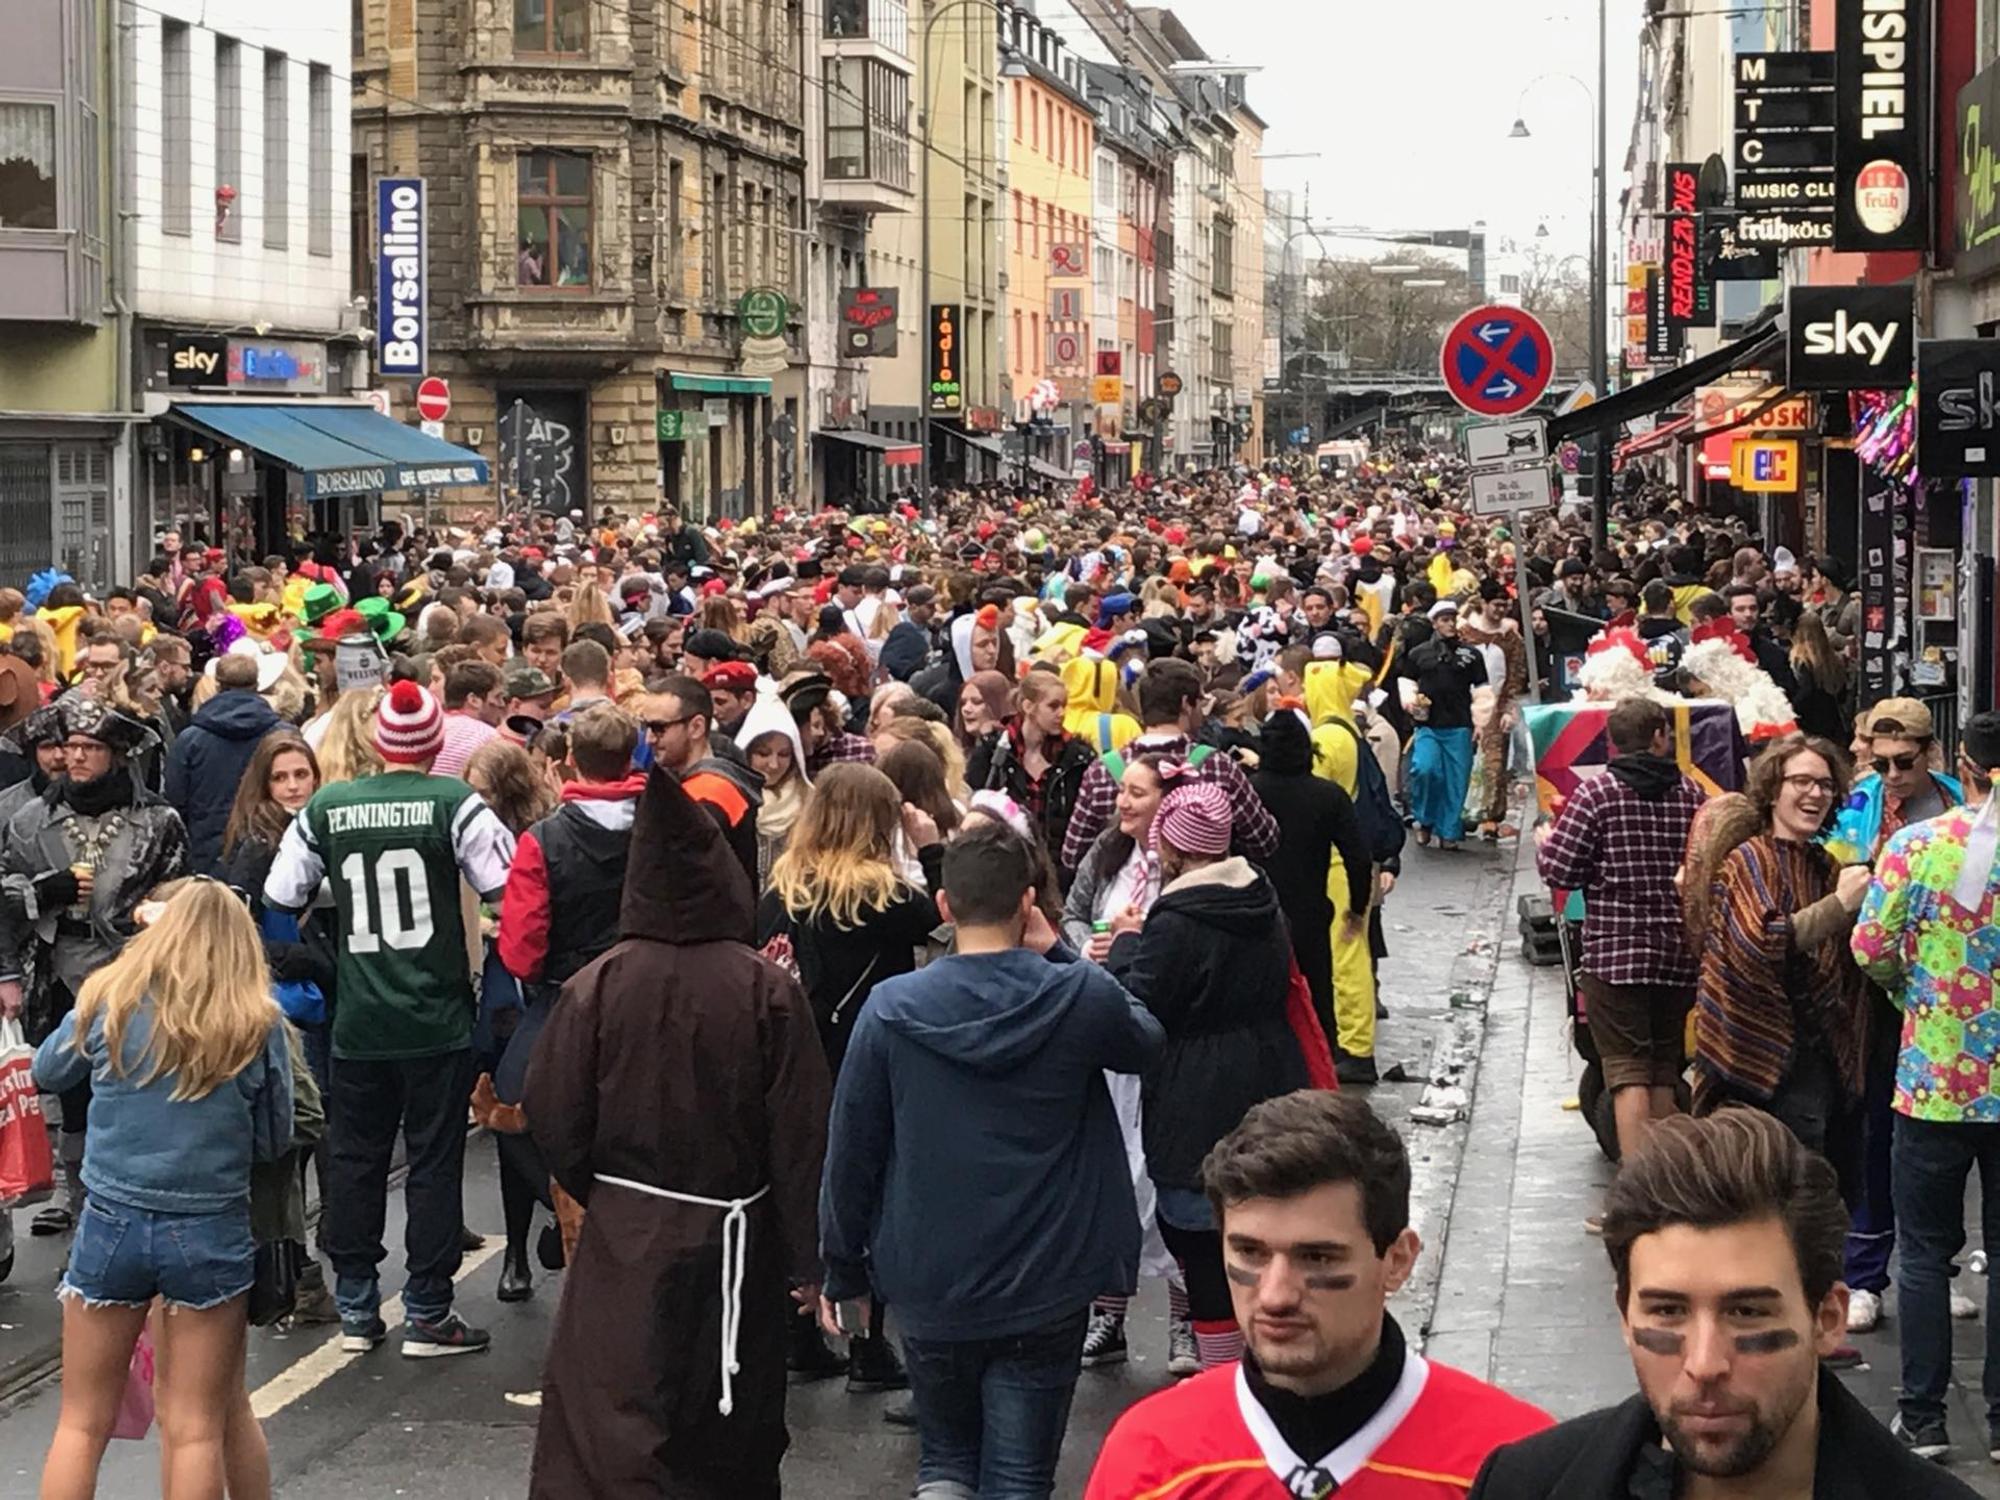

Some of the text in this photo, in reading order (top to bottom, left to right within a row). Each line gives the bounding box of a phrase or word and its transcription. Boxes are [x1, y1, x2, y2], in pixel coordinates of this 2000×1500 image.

[1741, 183, 1800, 199] MUSIC
[1671, 170, 1697, 319] RENDEZVOUS
[383, 186, 419, 366] Borsalino
[1804, 308, 1899, 366] sky
[174, 346, 219, 375] sky
[316, 468, 386, 495] BORSALINO
[326, 800, 436, 834] PENNINGTON
[340, 848, 434, 954] 10
